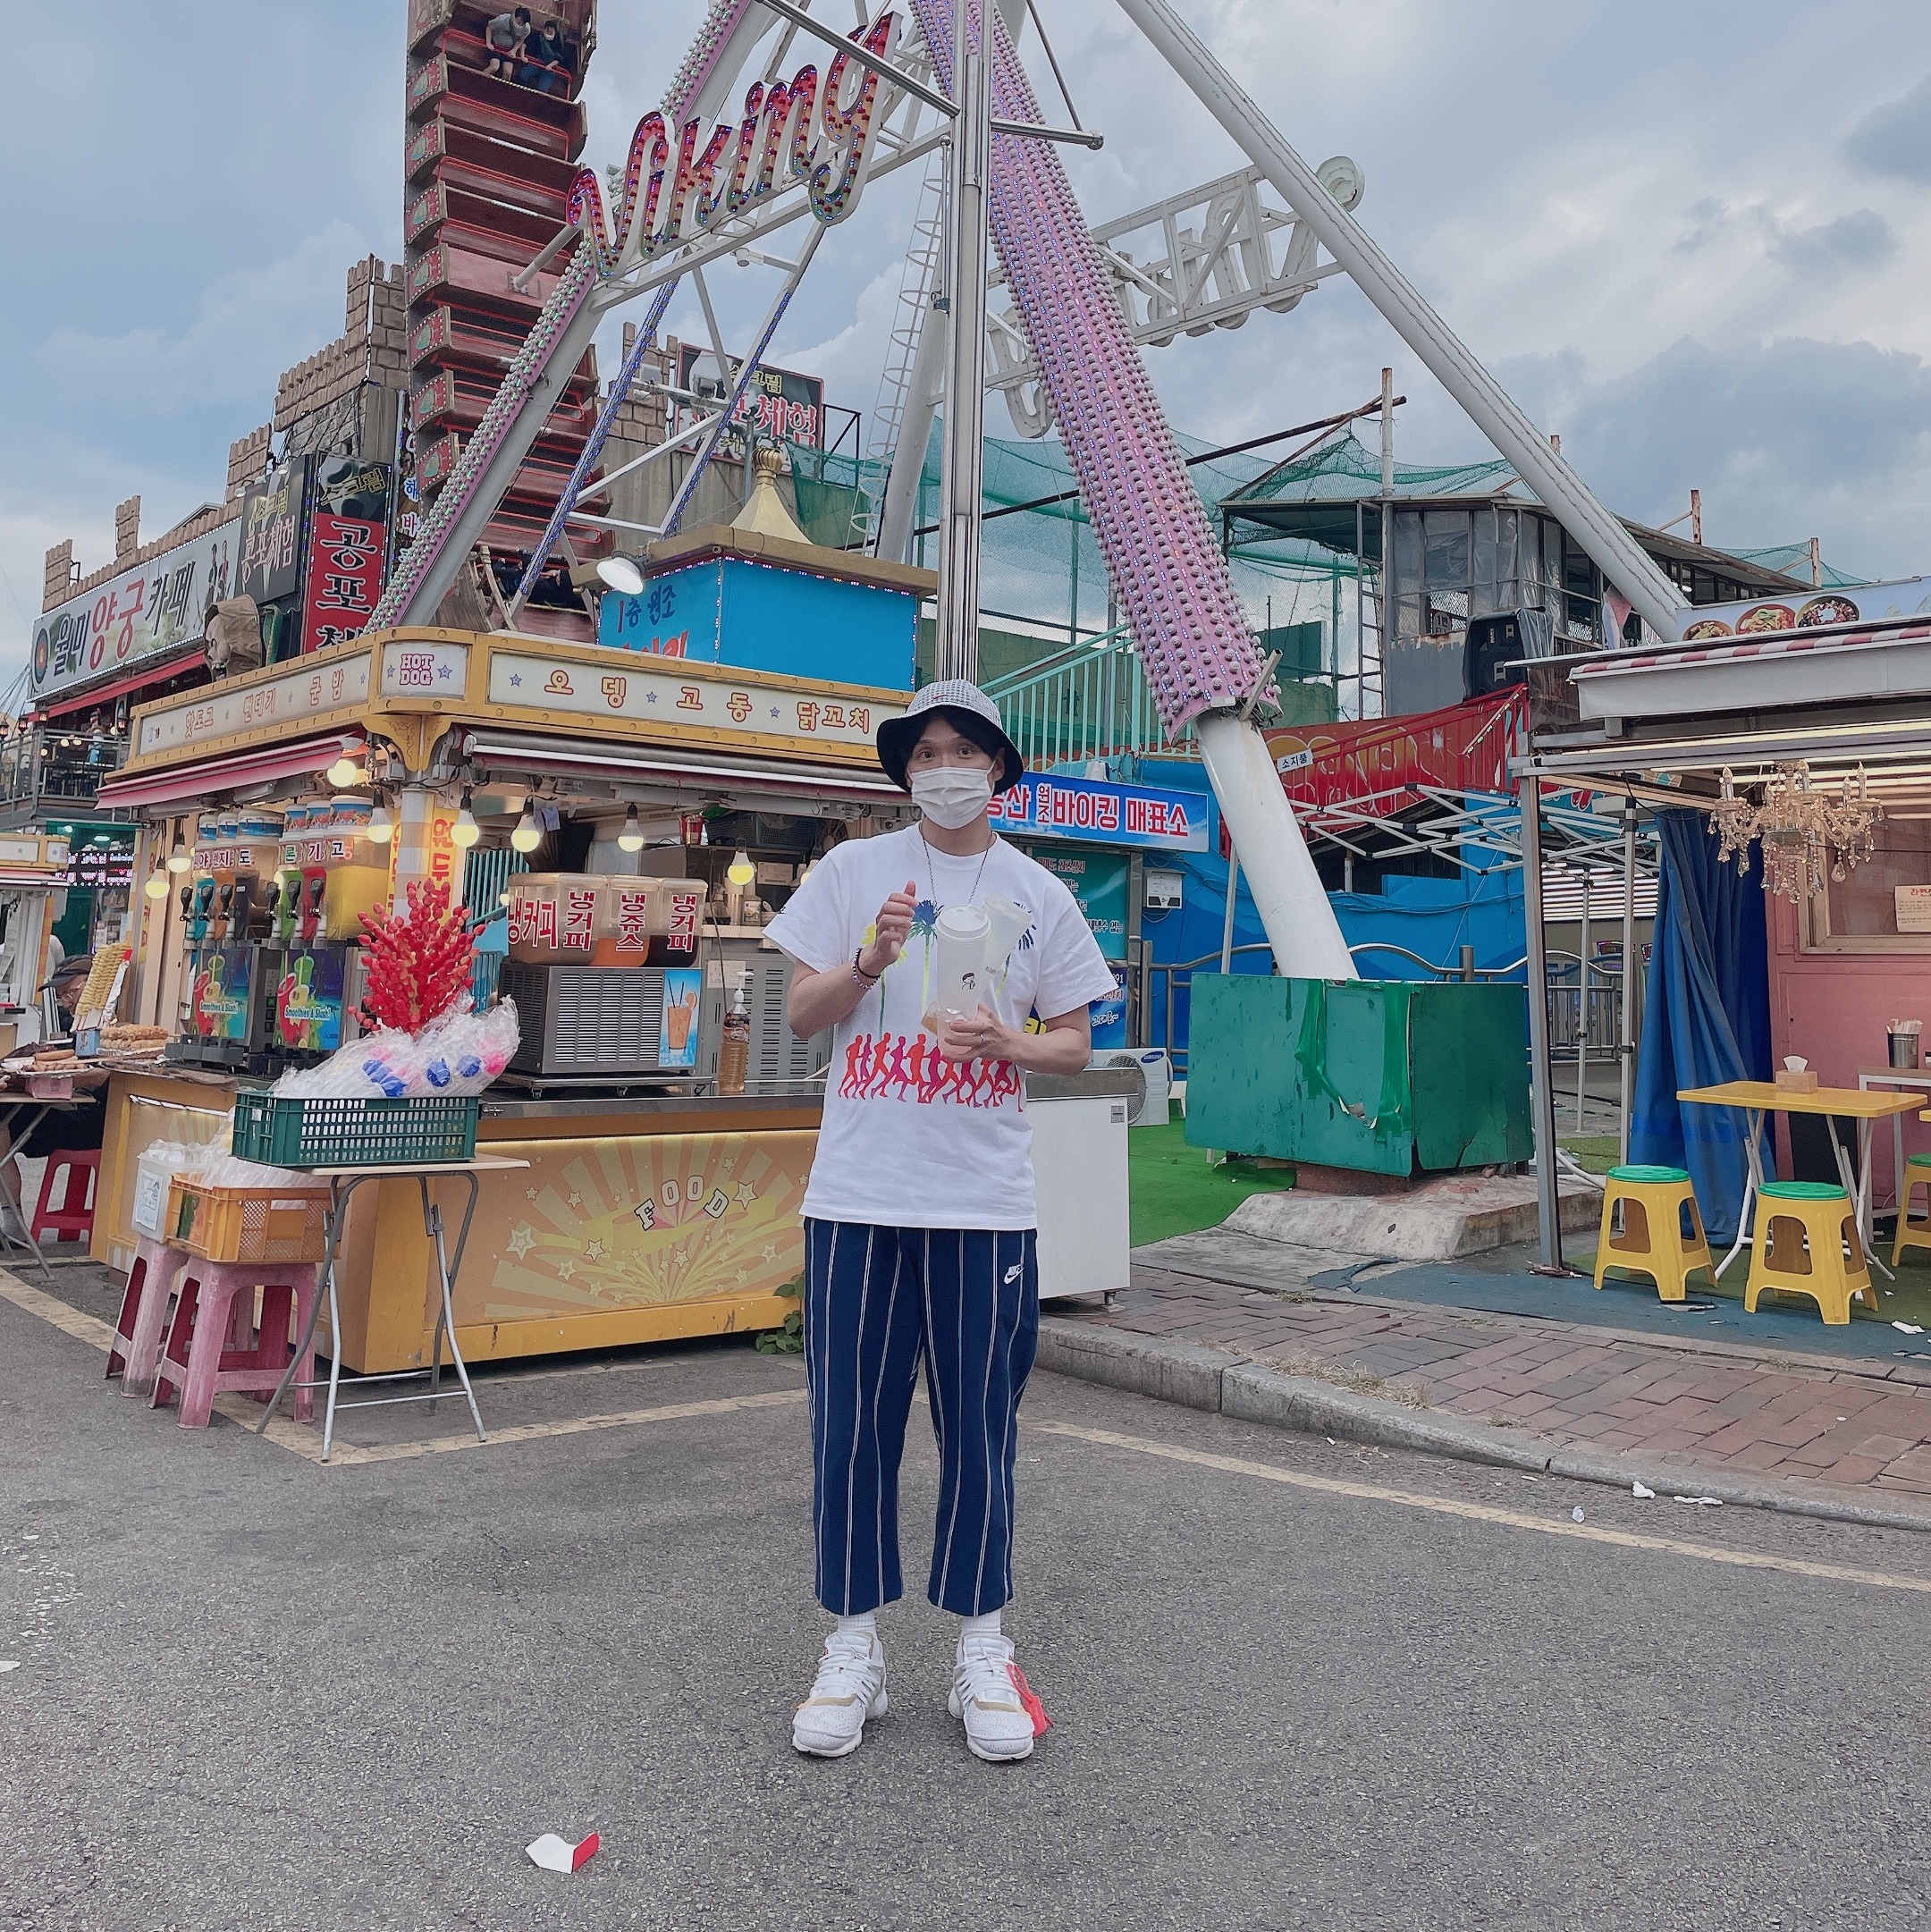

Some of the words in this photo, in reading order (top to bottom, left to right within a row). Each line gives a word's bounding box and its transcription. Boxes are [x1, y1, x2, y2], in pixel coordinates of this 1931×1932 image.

[566, 12, 899, 274] Viking
[241, 515, 295, 583] 공포체험
[54, 610, 91, 676] 월미
[89, 578, 145, 670] 양궁
[145, 561, 196, 637] 카페
[647, 584, 677, 625] 원조
[400, 669, 434, 685] DOG
[401, 654, 434, 670] HOT
[185, 705, 215, 739] 핫도그
[797, 702, 870, 734] 닭꼬치
[1037, 785, 1050, 823] 원조
[1053, 789, 1118, 831] 바이킹
[1126, 797, 1189, 838] 매표소
[508, 898, 558, 949] 냉커피
[563, 891, 595, 951] 냉커피
[616, 894, 645, 952] 냉쥬스
[667, 894, 697, 952] 냉커피
[634, 1175, 729, 1231] FOOD
